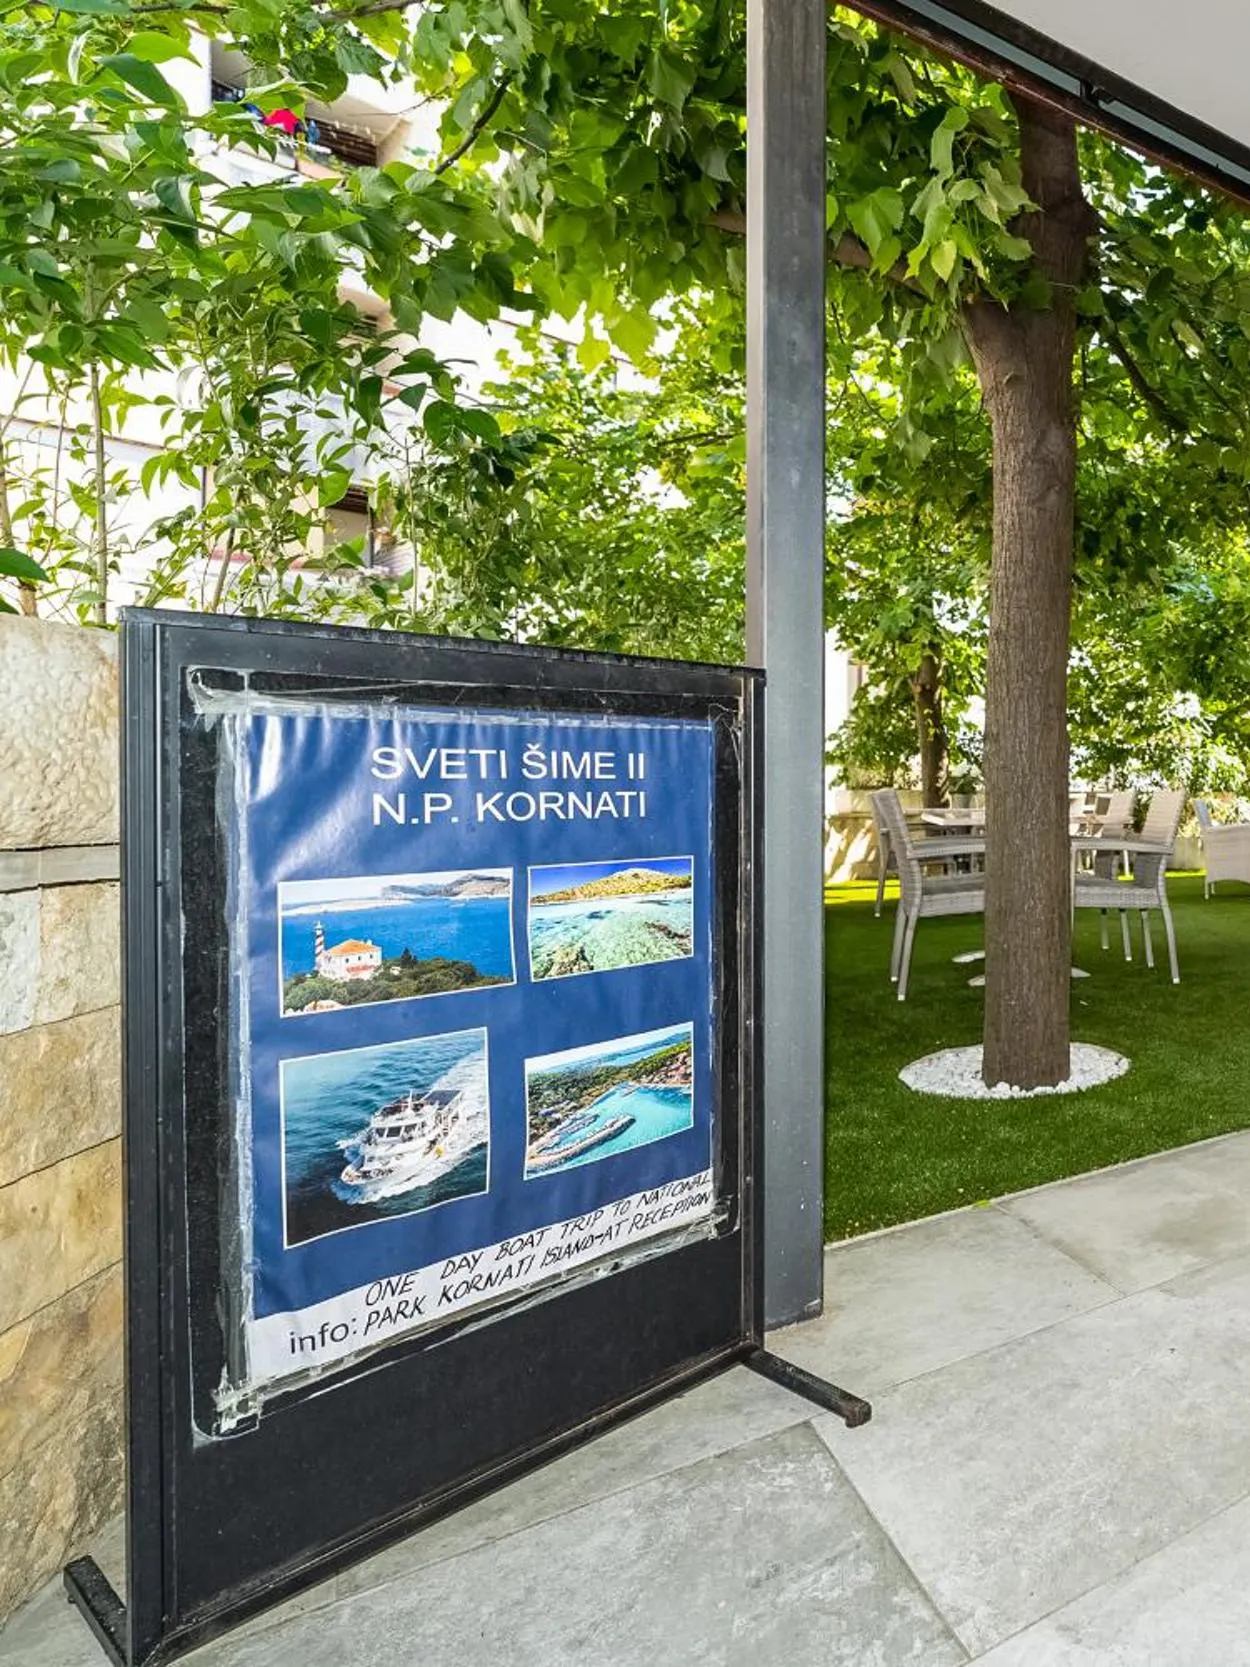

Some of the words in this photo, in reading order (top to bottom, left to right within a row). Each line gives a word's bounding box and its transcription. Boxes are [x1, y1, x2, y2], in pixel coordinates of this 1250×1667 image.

[371, 746, 508, 780] SVETI
[521, 743, 616, 780] ŠIME
[628, 752, 645, 780] II
[373, 793, 459, 825] N.P.
[475, 790, 646, 822] KORNATI
[289, 1317, 358, 1355] info:
[363, 1294, 427, 1336] PARK
[437, 1253, 535, 1307] KORNATI
[628, 1192, 713, 1234] RECEPTION
[365, 1272, 420, 1307] ONE
[439, 1251, 484, 1280] DAY
[494, 1228, 551, 1261] BOAT
[560, 1209, 604, 1240] TRIP
[612, 1199, 631, 1216] TO
[636, 1171, 712, 1208] NATIONAL
